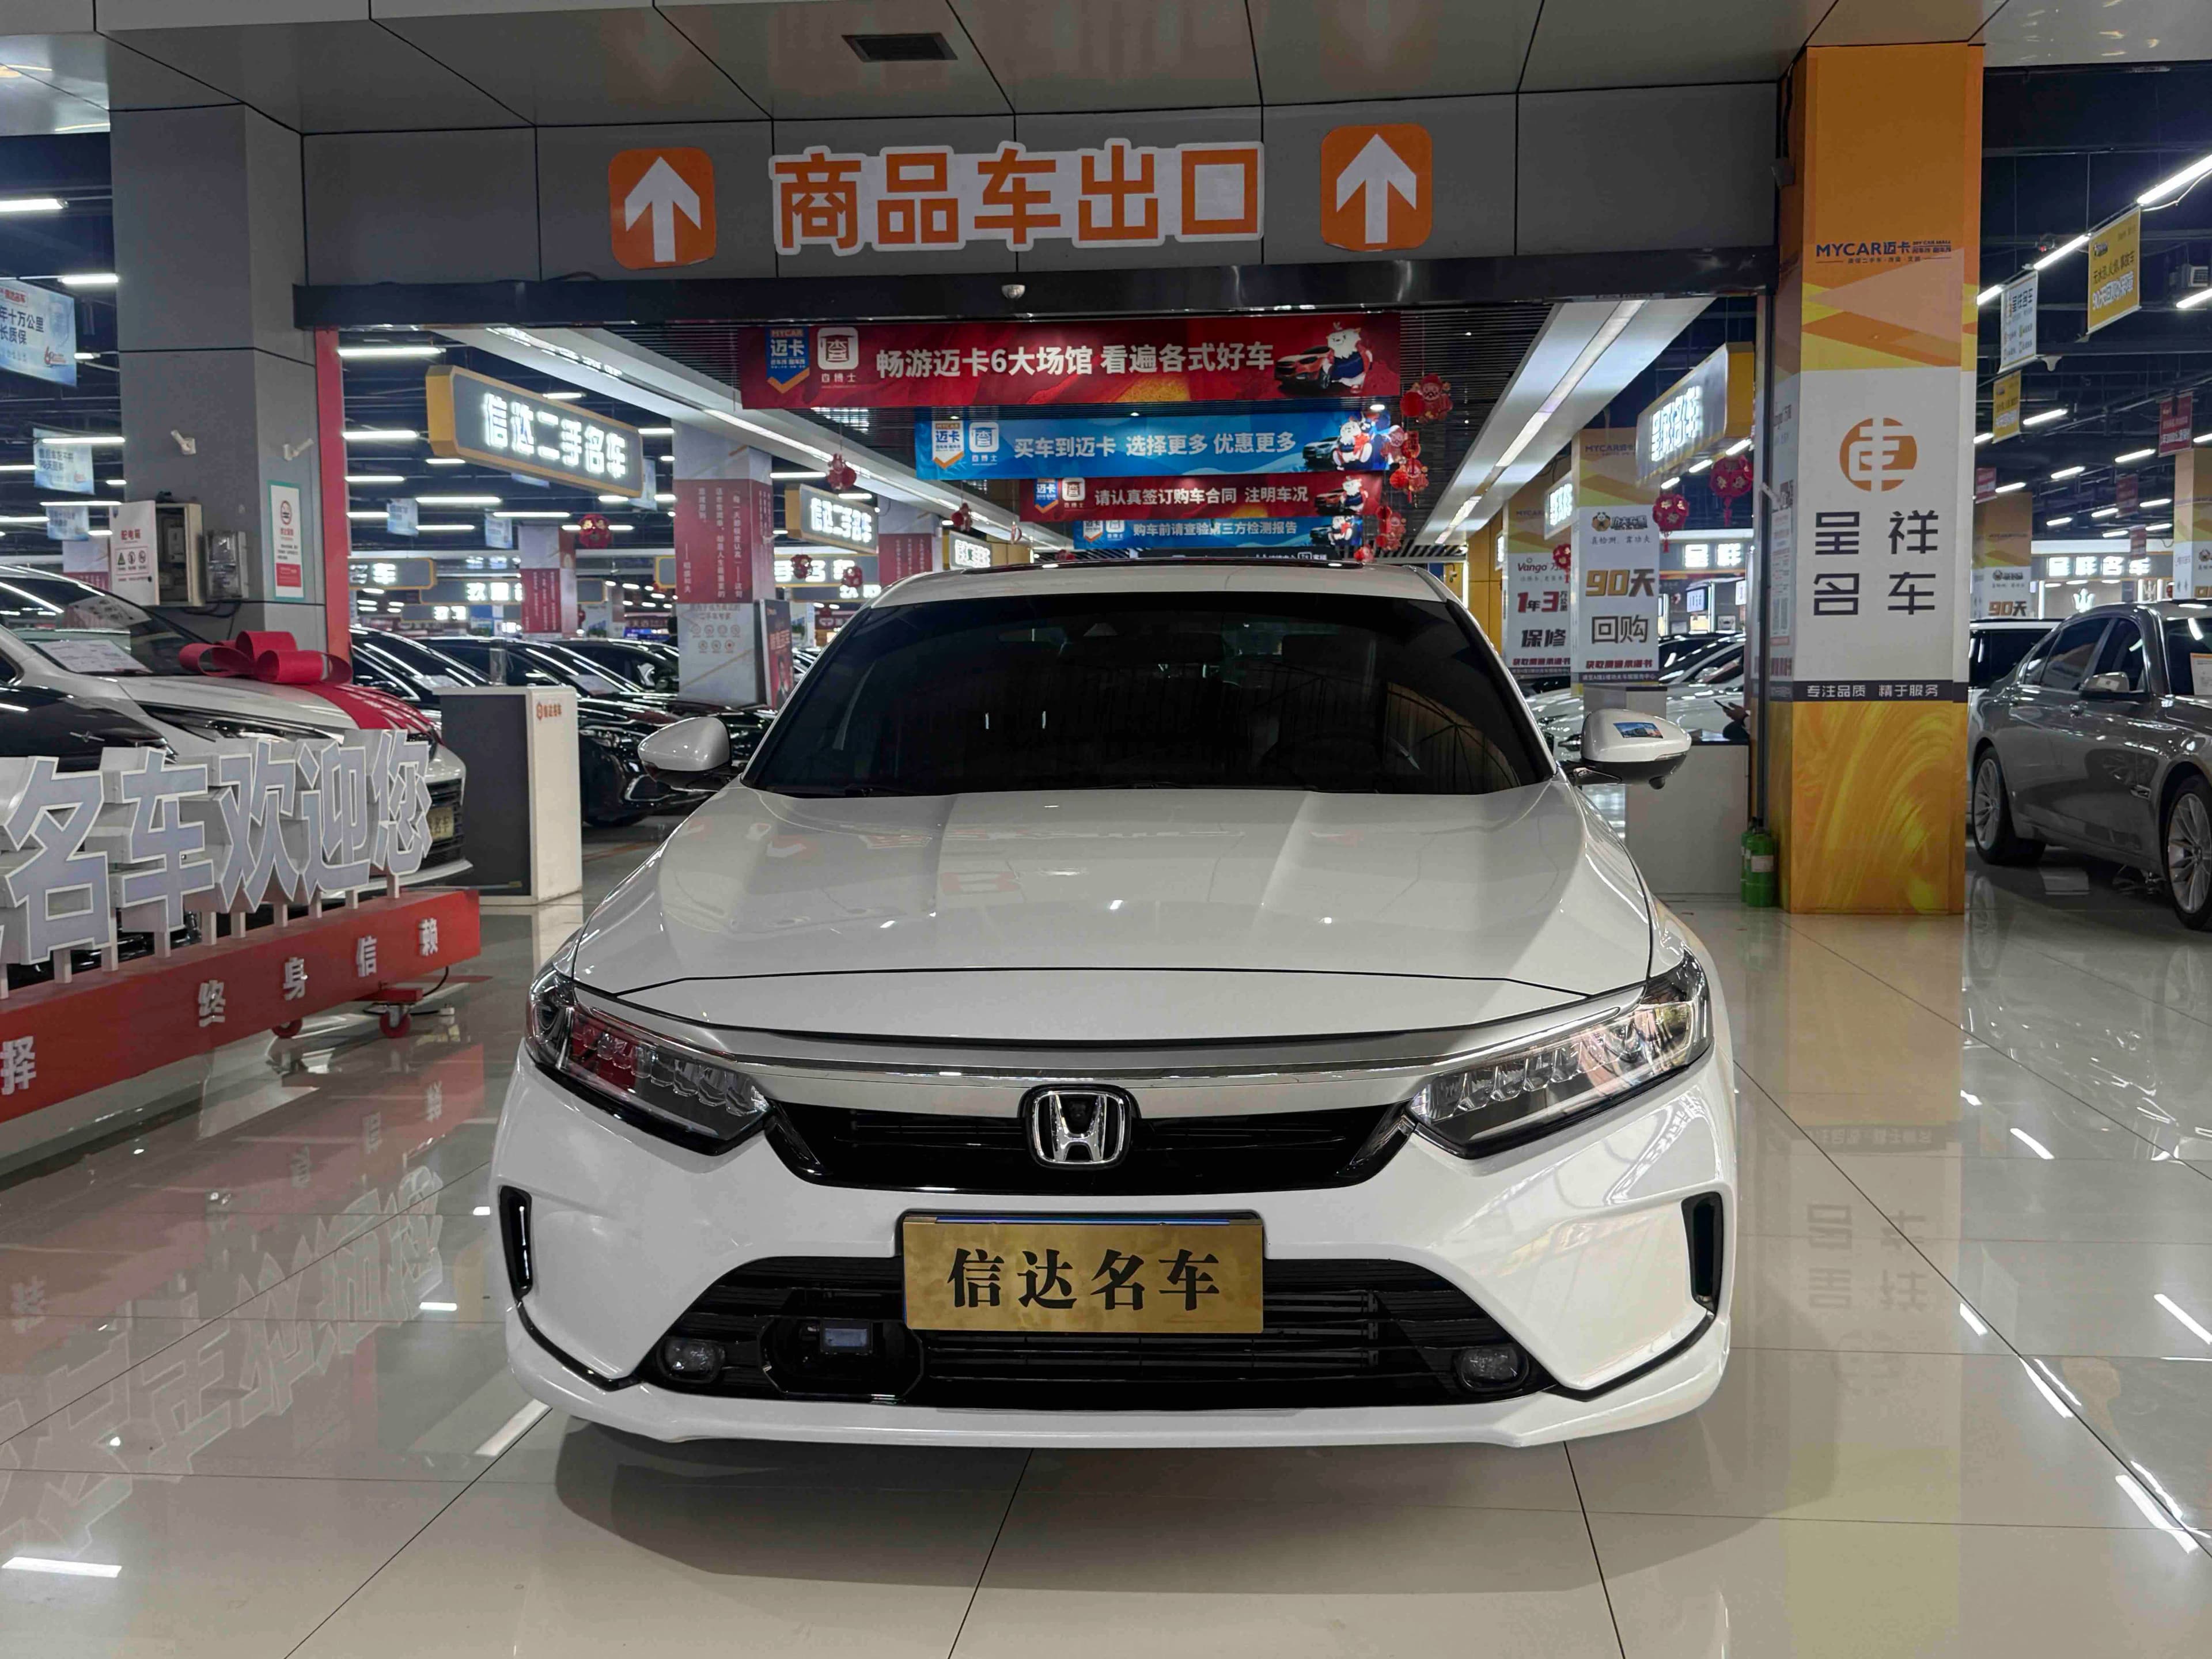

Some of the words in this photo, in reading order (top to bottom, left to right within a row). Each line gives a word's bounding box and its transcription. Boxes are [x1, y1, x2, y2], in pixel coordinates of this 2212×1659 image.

[775, 144, 1259, 249] 商品车出口
[1816, 241, 1911, 257] MYCAR迈卡
[770, 339, 805, 357] 迈卡
[876, 347, 1092, 379] 畅游迈卡6大场馆
[1100, 341, 1274, 374] 看遍各式好车
[483, 392, 628, 479] 信达二手名车
[935, 430, 960, 443] 迈卡
[1014, 436, 1116, 459] 买车到迈卡
[1126, 434, 1209, 457] 选择更多
[1213, 431, 1297, 454] 优惠更多
[1094, 487, 1237, 506] 请认真签订购车合同
[1245, 486, 1309, 503] 注明车况
[120, 528, 141, 540] 配电箱
[1133, 521, 1297, 536] 购车前请查验第三方检测报告
[1815, 510, 1939, 555] 呈祥
[1517, 562, 1548, 573] Vango
[1585, 569, 1656, 597] 90天
[1813, 571, 1936, 616] 名车
[1988, 600, 2027, 617] 90天
[1521, 628, 1566, 648] 保修
[1591, 615, 1649, 645] 回购
[1806, 684, 1866, 698] 专注品质
[1878, 683, 1938, 697] 精于服务
[2, 729, 433, 965] 名车欢迎您
[1, 1036, 37, 1096] 择
[198, 918, 440, 1028] 终身信赖
[947, 1248, 1221, 1312] 信达名车
